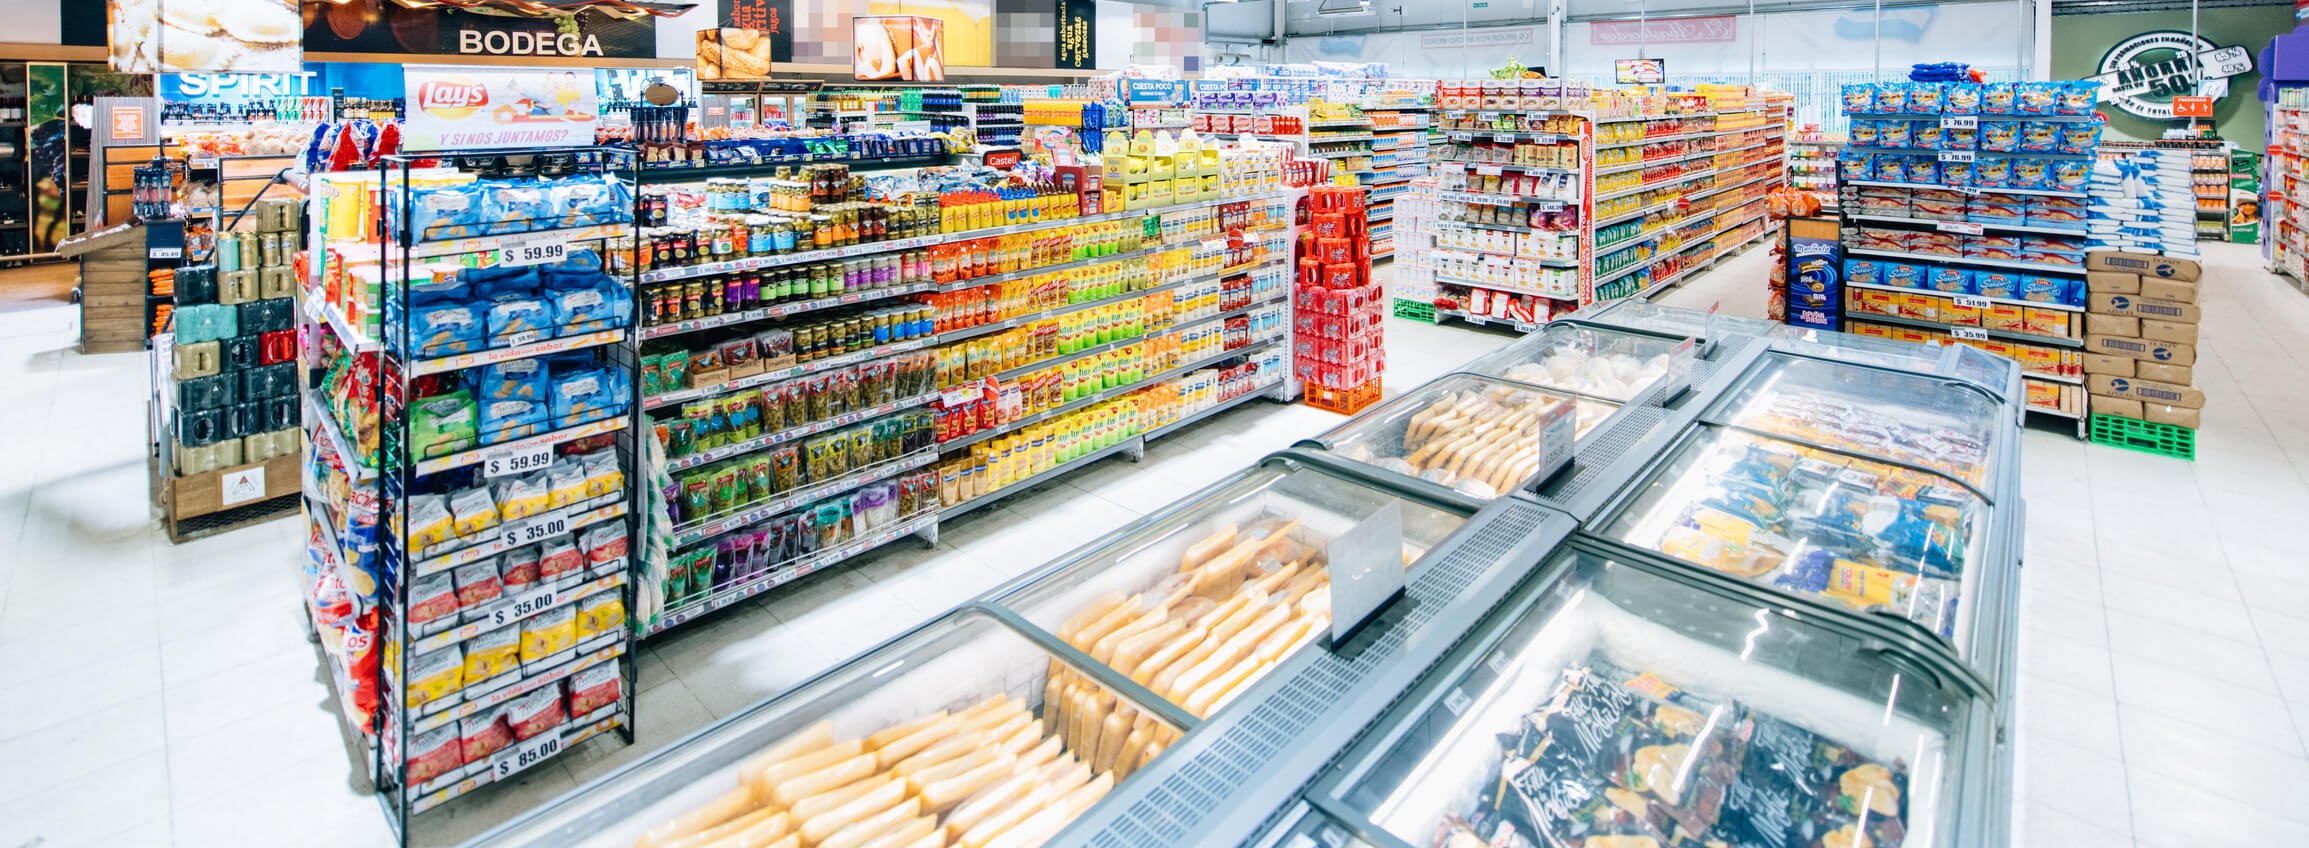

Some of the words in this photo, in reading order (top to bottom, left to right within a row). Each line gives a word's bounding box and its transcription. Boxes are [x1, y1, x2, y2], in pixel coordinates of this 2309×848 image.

[459, 29, 604, 57] BODEGA
[494, 129, 569, 144] JUNTAMOS?
[990, 155, 1017, 166] Castell
[505, 249, 514, 262] $
[524, 244, 563, 261] 59.99
[1966, 300, 1987, 308] 51.99
[1964, 332, 1986, 340] 35.99
[491, 460, 500, 474] $
[510, 452, 549, 471] 59.99
[506, 531, 517, 546] $
[526, 519, 565, 540] 35.00
[495, 610, 505, 625] $
[514, 593, 552, 618] 35.00
[499, 761, 509, 775] $
[519, 739, 558, 767] 85.00
